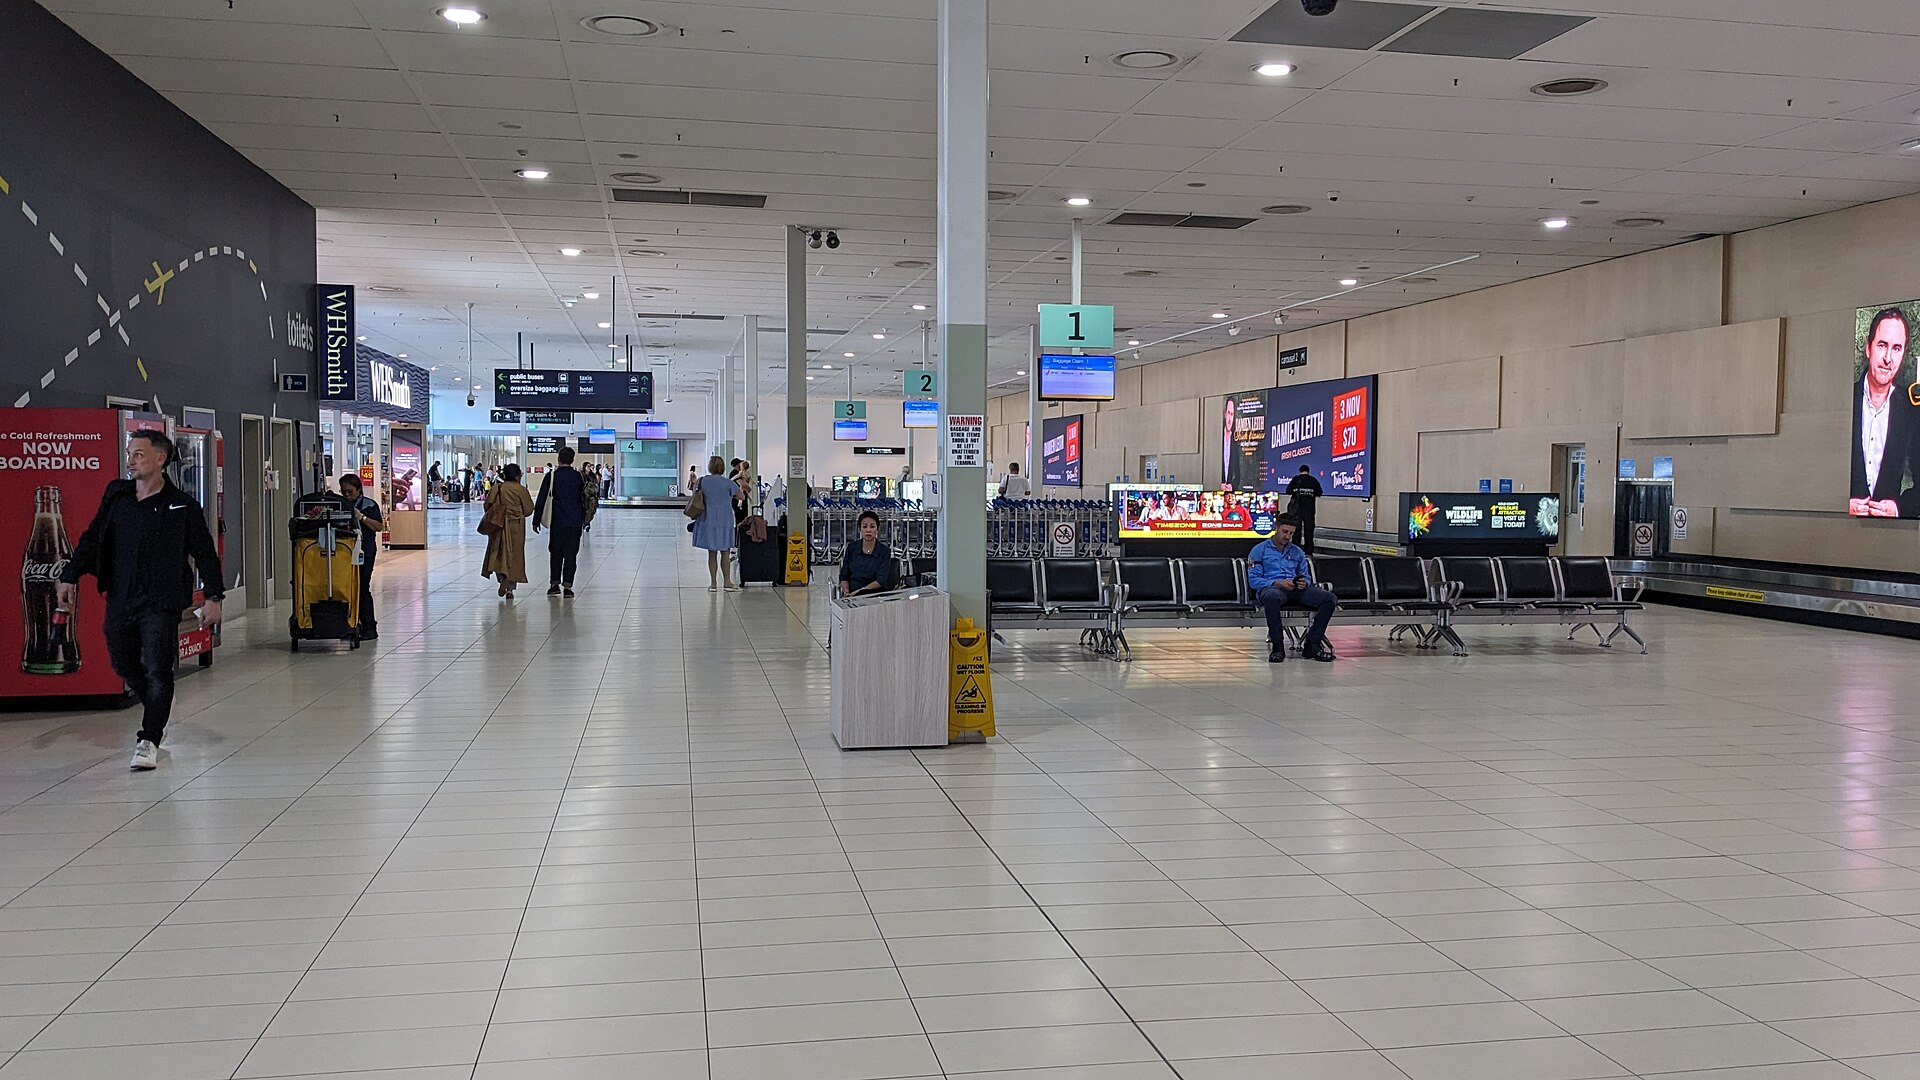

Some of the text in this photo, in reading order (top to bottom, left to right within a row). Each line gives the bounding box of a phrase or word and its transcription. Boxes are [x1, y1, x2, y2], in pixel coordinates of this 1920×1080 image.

[287, 311, 314, 352] toilets
[1069, 312, 1085, 340] 1
[326, 290, 348, 396] WHSmith
[370, 360, 411, 409] WHSmith
[921, 375, 932, 392] 2
[846, 404, 854, 416] 3
[1340, 400, 1345, 419] 3
[1346, 395, 1361, 418] NOV
[949, 416, 982, 426] WARNING
[1236, 416, 1264, 432] DAMIEN LEITH
[10, 432, 33, 440] Cold
[36, 432, 101, 440] Refreshment
[1272, 418, 1300, 449] DAMIEN
[1301, 411, 1324, 440] LEITH
[1342, 426, 1356, 449] $70
[23, 442, 72, 454] NOW
[628, 442, 634, 450] 4
[1281, 446, 1311, 460] IRISH CLASSICS
[0, 457, 100, 469] BOARDING
[1446, 510, 1482, 520] WILDLIFE
[22, 559, 70, 579] Coca-C
